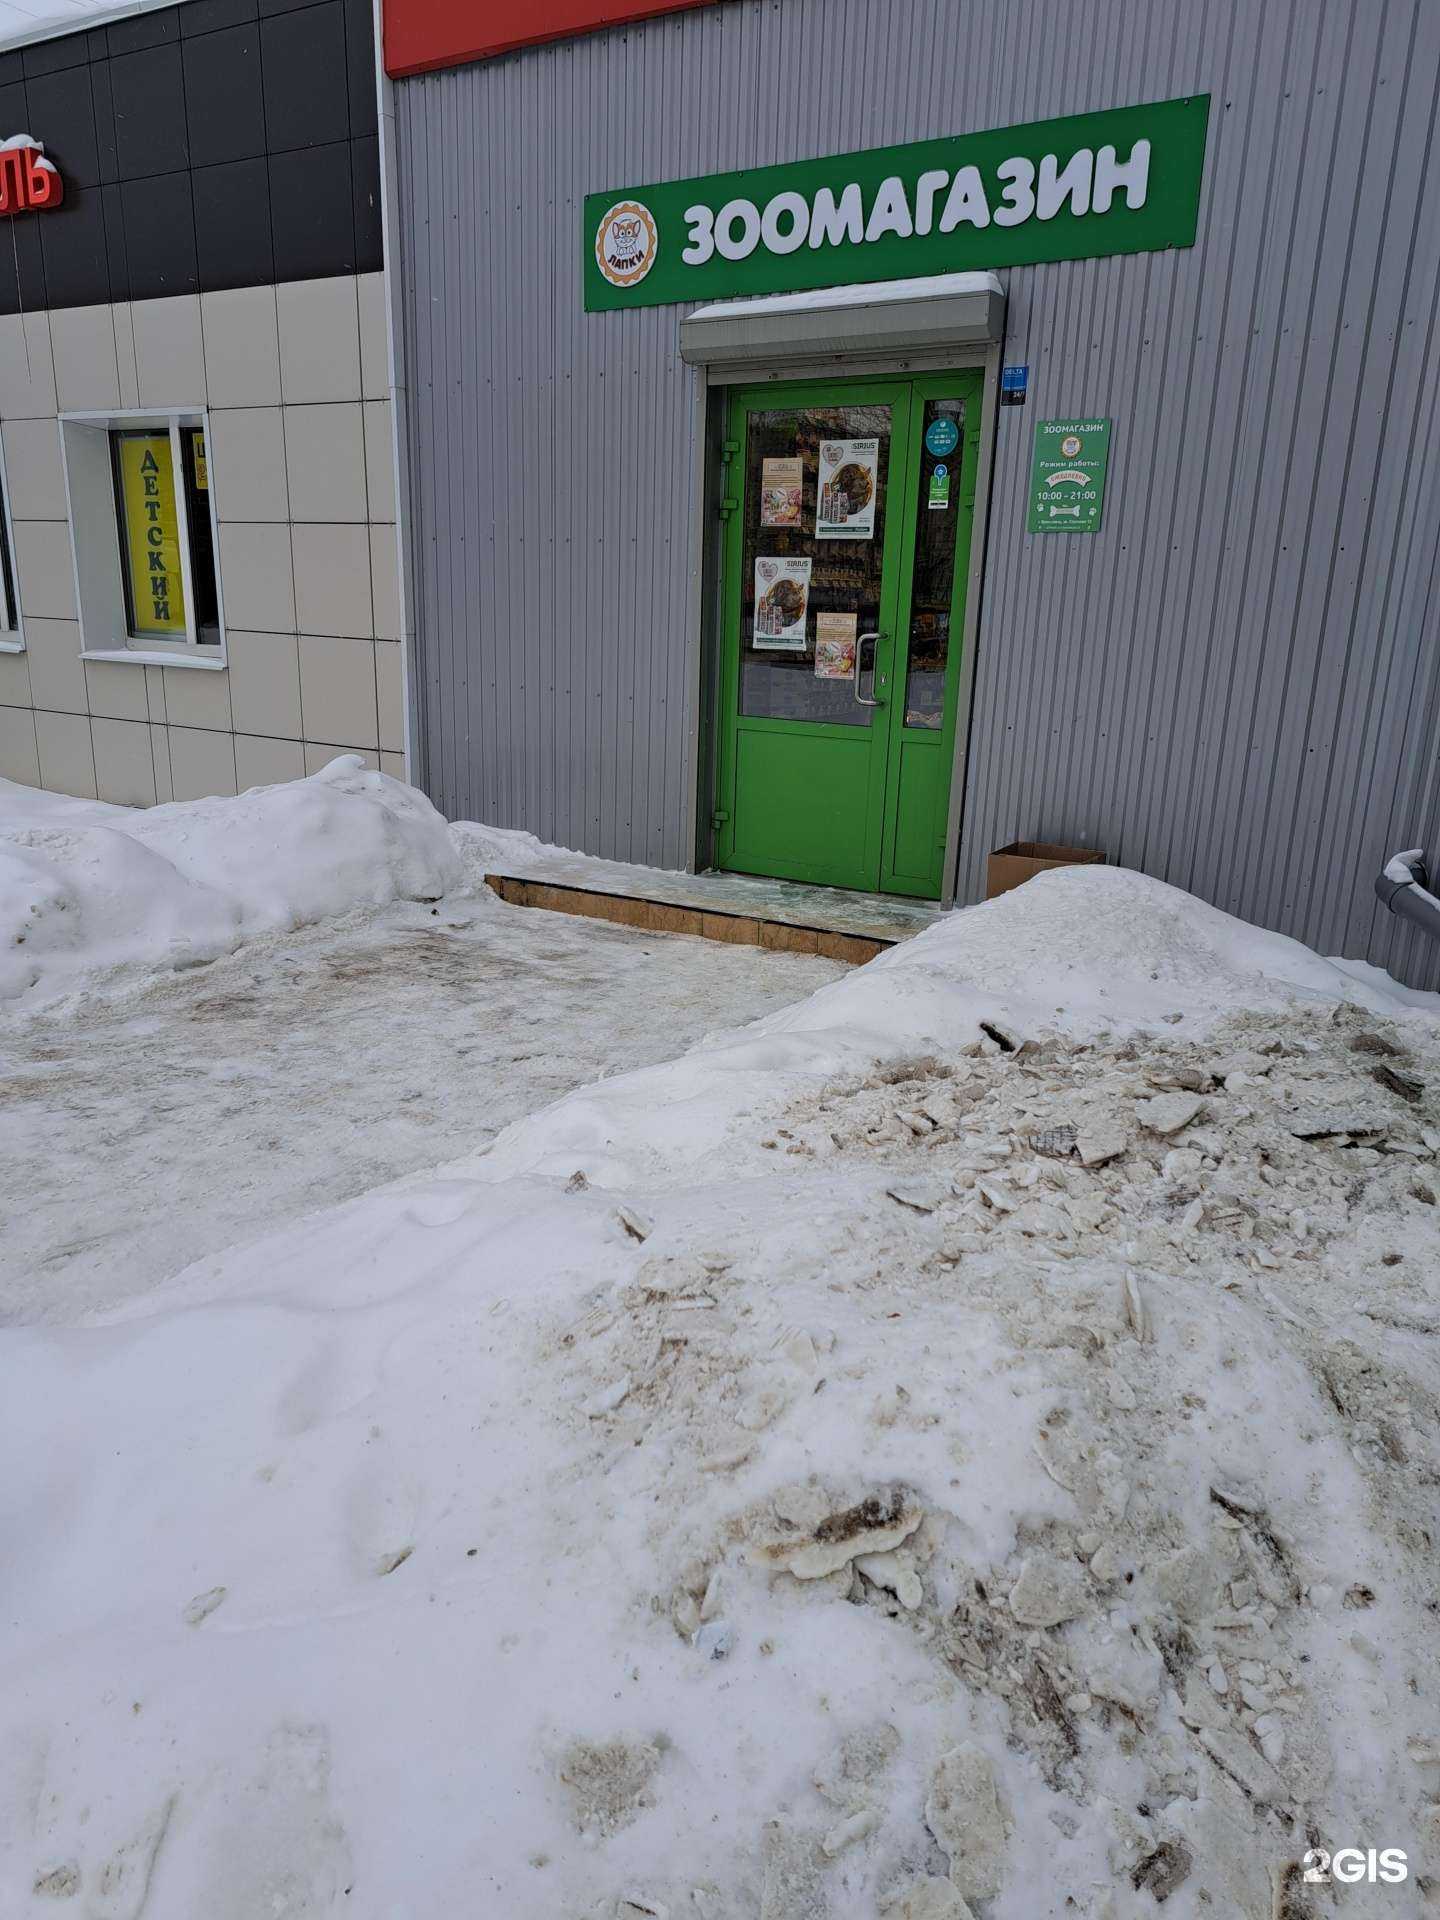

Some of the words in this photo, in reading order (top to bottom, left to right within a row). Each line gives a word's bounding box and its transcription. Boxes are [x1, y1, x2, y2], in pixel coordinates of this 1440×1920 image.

[681, 139, 1151, 265] ЗООМАГАЗИН
[608, 250, 645, 270] ЛАПКИ
[1043, 424, 1104, 434] ЗООМАГАЗИН
[1037, 491, 1062, 500] 10:00
[1070, 490, 1096, 500] 21:00
[141, 449, 170, 621] ДЕТСКИЙ
